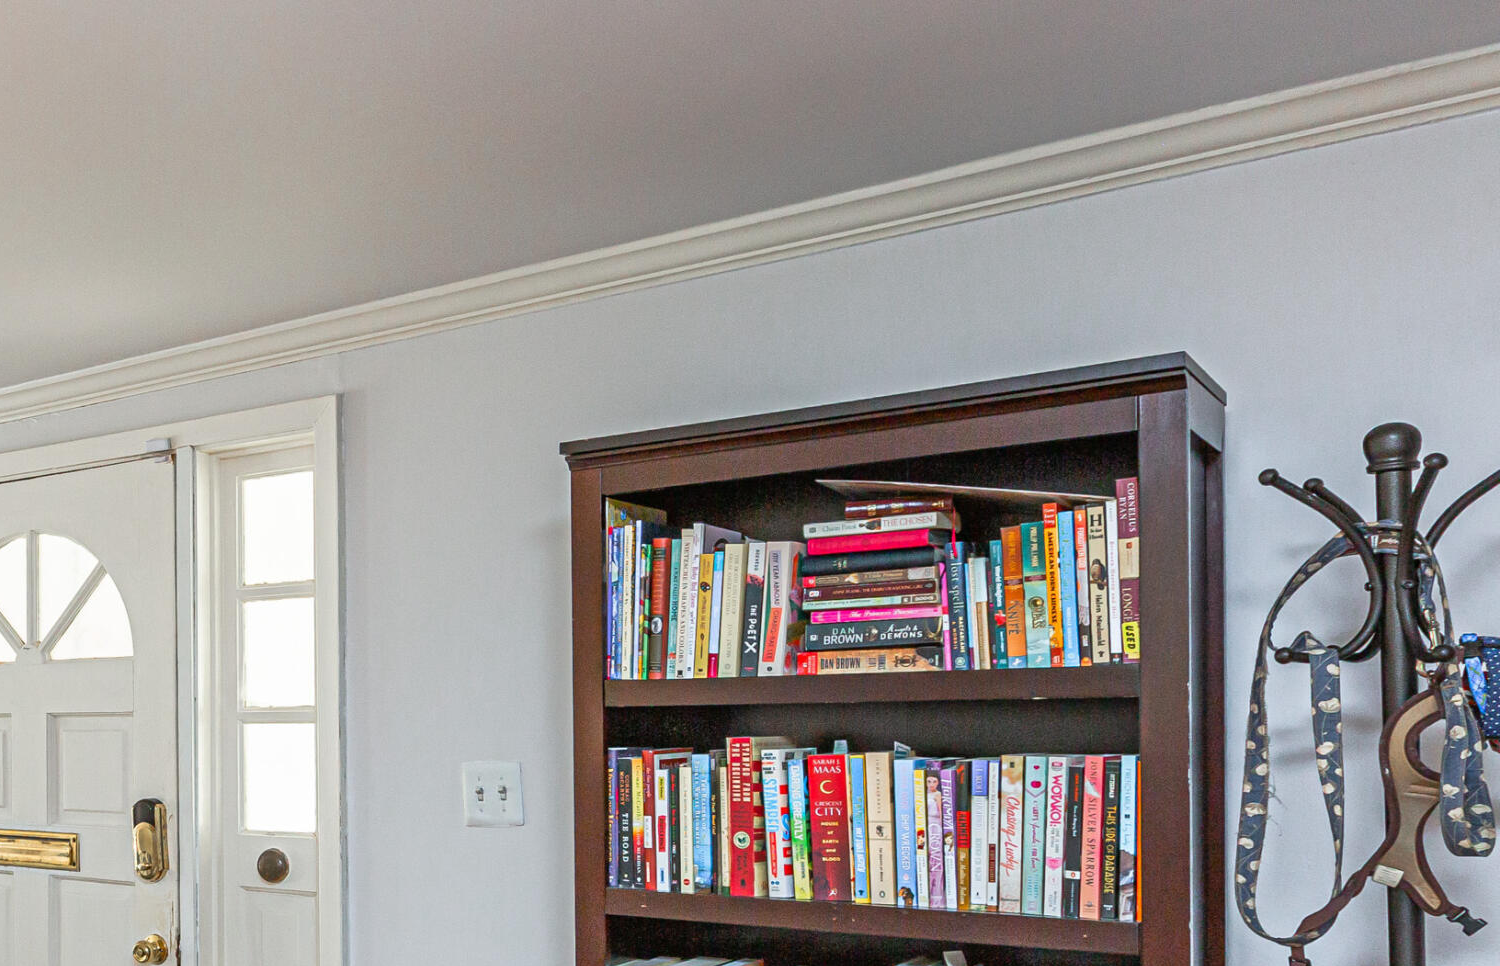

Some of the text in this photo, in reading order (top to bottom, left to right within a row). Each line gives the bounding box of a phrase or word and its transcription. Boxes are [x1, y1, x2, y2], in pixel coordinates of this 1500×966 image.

[883, 516, 932, 527] THE CHOSEN
[1127, 483, 1136, 532] CORNELIUS
[682, 542, 690, 580] NIETZSCHE
[950, 562, 963, 613] lost spells
[1122, 588, 1133, 621] LONGE
[747, 619, 757, 640] POET
[1008, 601, 1020, 635] KNIFE
[678, 636, 686, 663] COLORS
[745, 641, 756, 653] X
[823, 634, 863, 644] BROWN
[880, 631, 923, 640] DEMONS
[1126, 626, 1135, 649] USED
[821, 658, 860, 669] DAN BROWN
[732, 743, 741, 802] THE BEGINNING
[813, 766, 842, 774] MAAS
[763, 779, 779, 832] STAMPED
[791, 766, 803, 840] DARING GREATLY
[815, 807, 842, 816] CITY
[930, 824, 941, 872] CROWN
[1001, 797, 1020, 870] Chasing Lucky
[1086, 799, 1096, 887] SILVER SPARROW
[1104, 806, 1116, 893] THIS SIDE OF PARADISE
[901, 833, 910, 870] WRECKED
